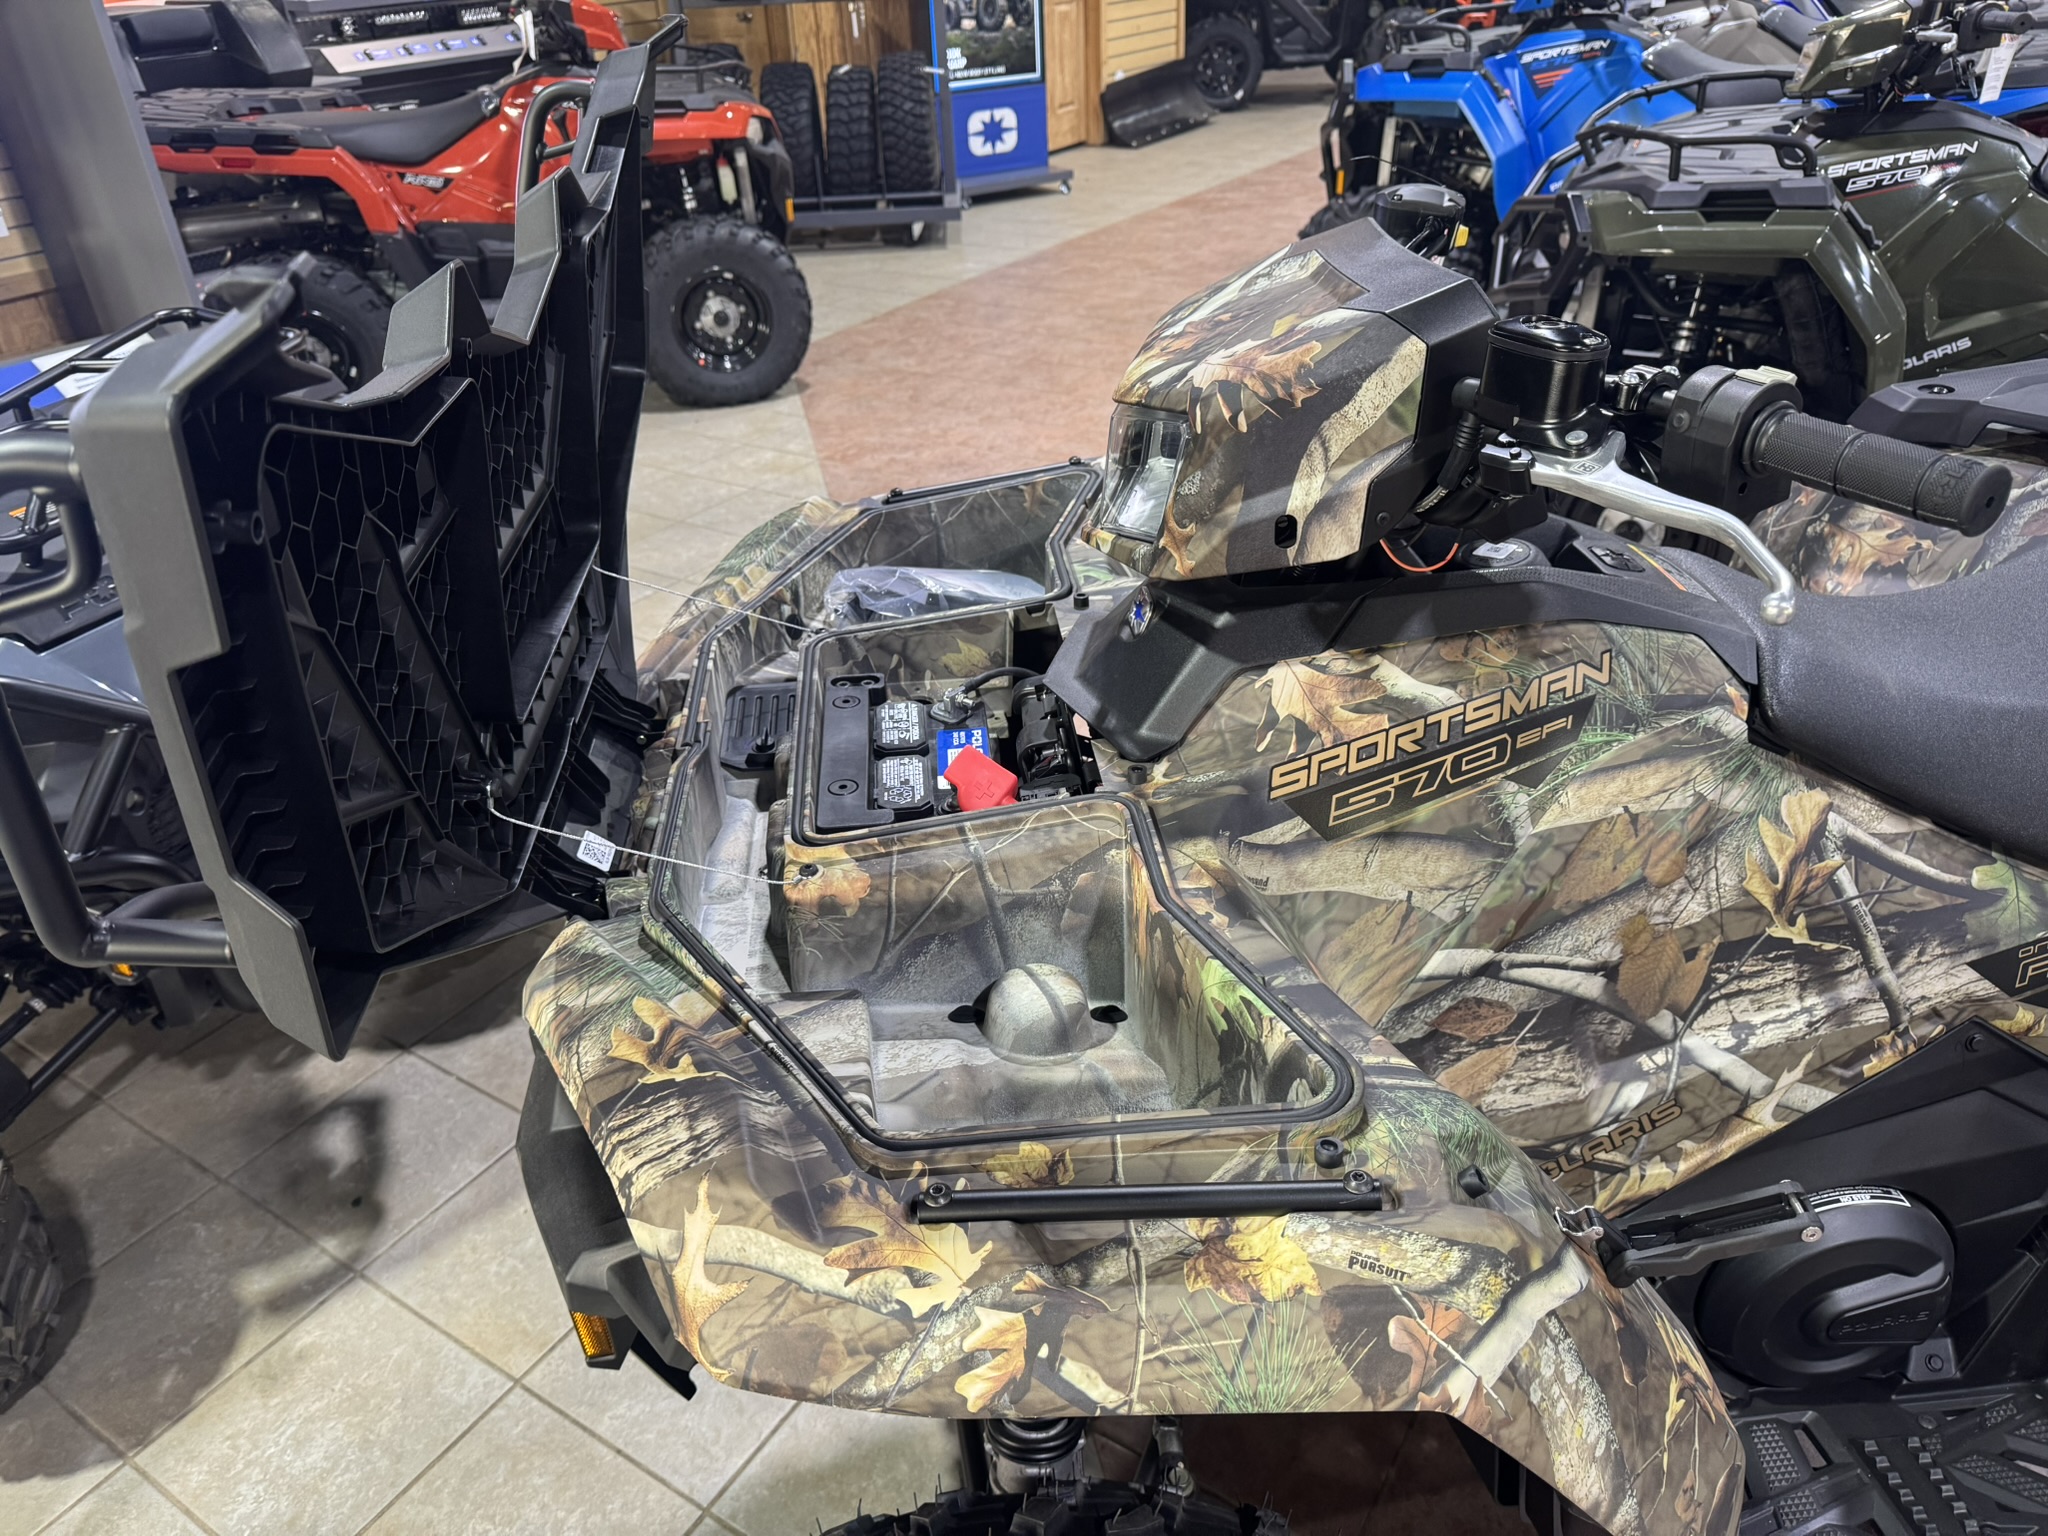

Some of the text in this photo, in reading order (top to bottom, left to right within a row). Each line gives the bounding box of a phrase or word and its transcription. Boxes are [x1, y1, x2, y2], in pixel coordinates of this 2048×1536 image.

[1520, 39, 1611, 64] SPORTSMAN
[1827, 140, 1981, 178] SPORTSMAN
[1846, 165, 1929, 193] 570
[1903, 336, 1972, 371] OLARIS
[1269, 651, 1612, 800] SPORTSMAN
[1328, 715, 1573, 827] 570 EFI
[1852, 904, 1873, 934] PURSUIT
[1540, 1098, 1683, 1180] OLARIS
[1347, 1256, 1409, 1282] PURSUIT
